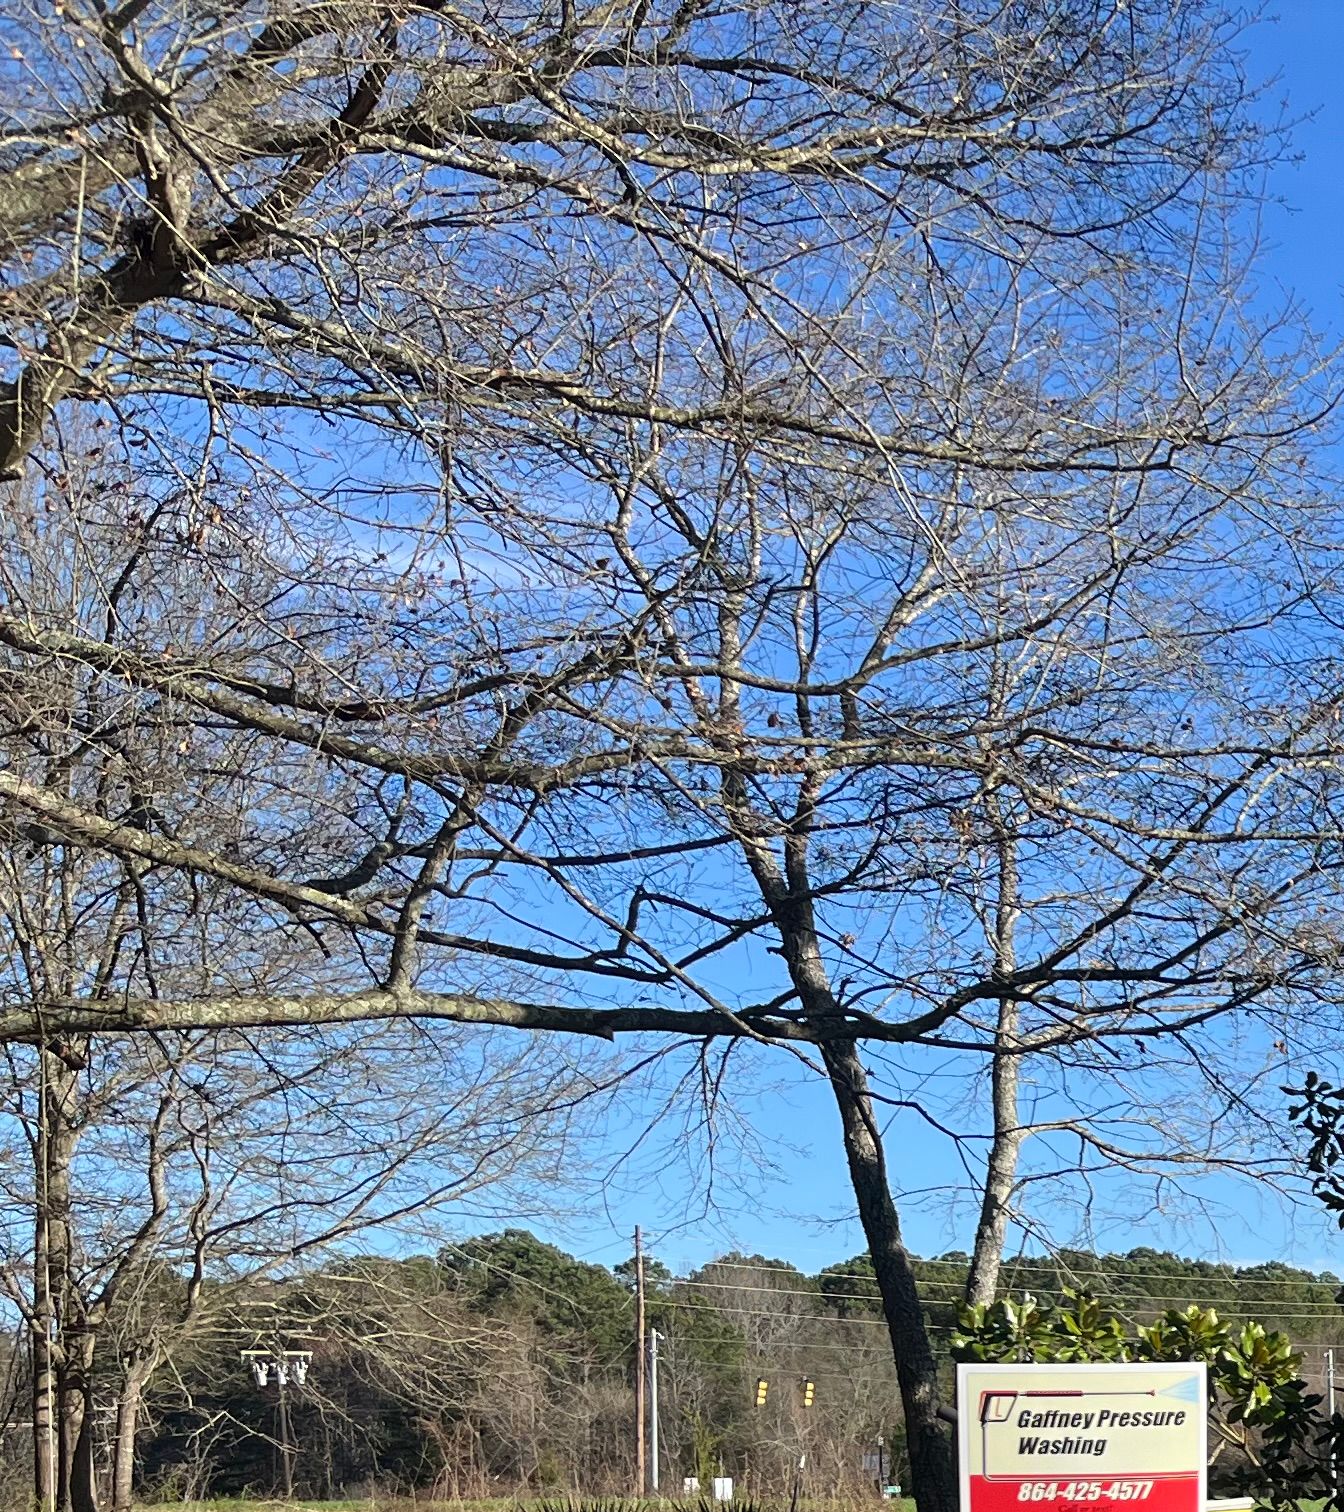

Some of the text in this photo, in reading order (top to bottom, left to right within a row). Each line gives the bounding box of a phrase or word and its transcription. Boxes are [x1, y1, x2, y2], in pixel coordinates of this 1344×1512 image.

[1017, 1410, 1185, 1429] Gaffney Pressure
[1018, 1437, 1107, 1457] Washing
[1017, 1481, 1154, 1501] 864-425-4577
